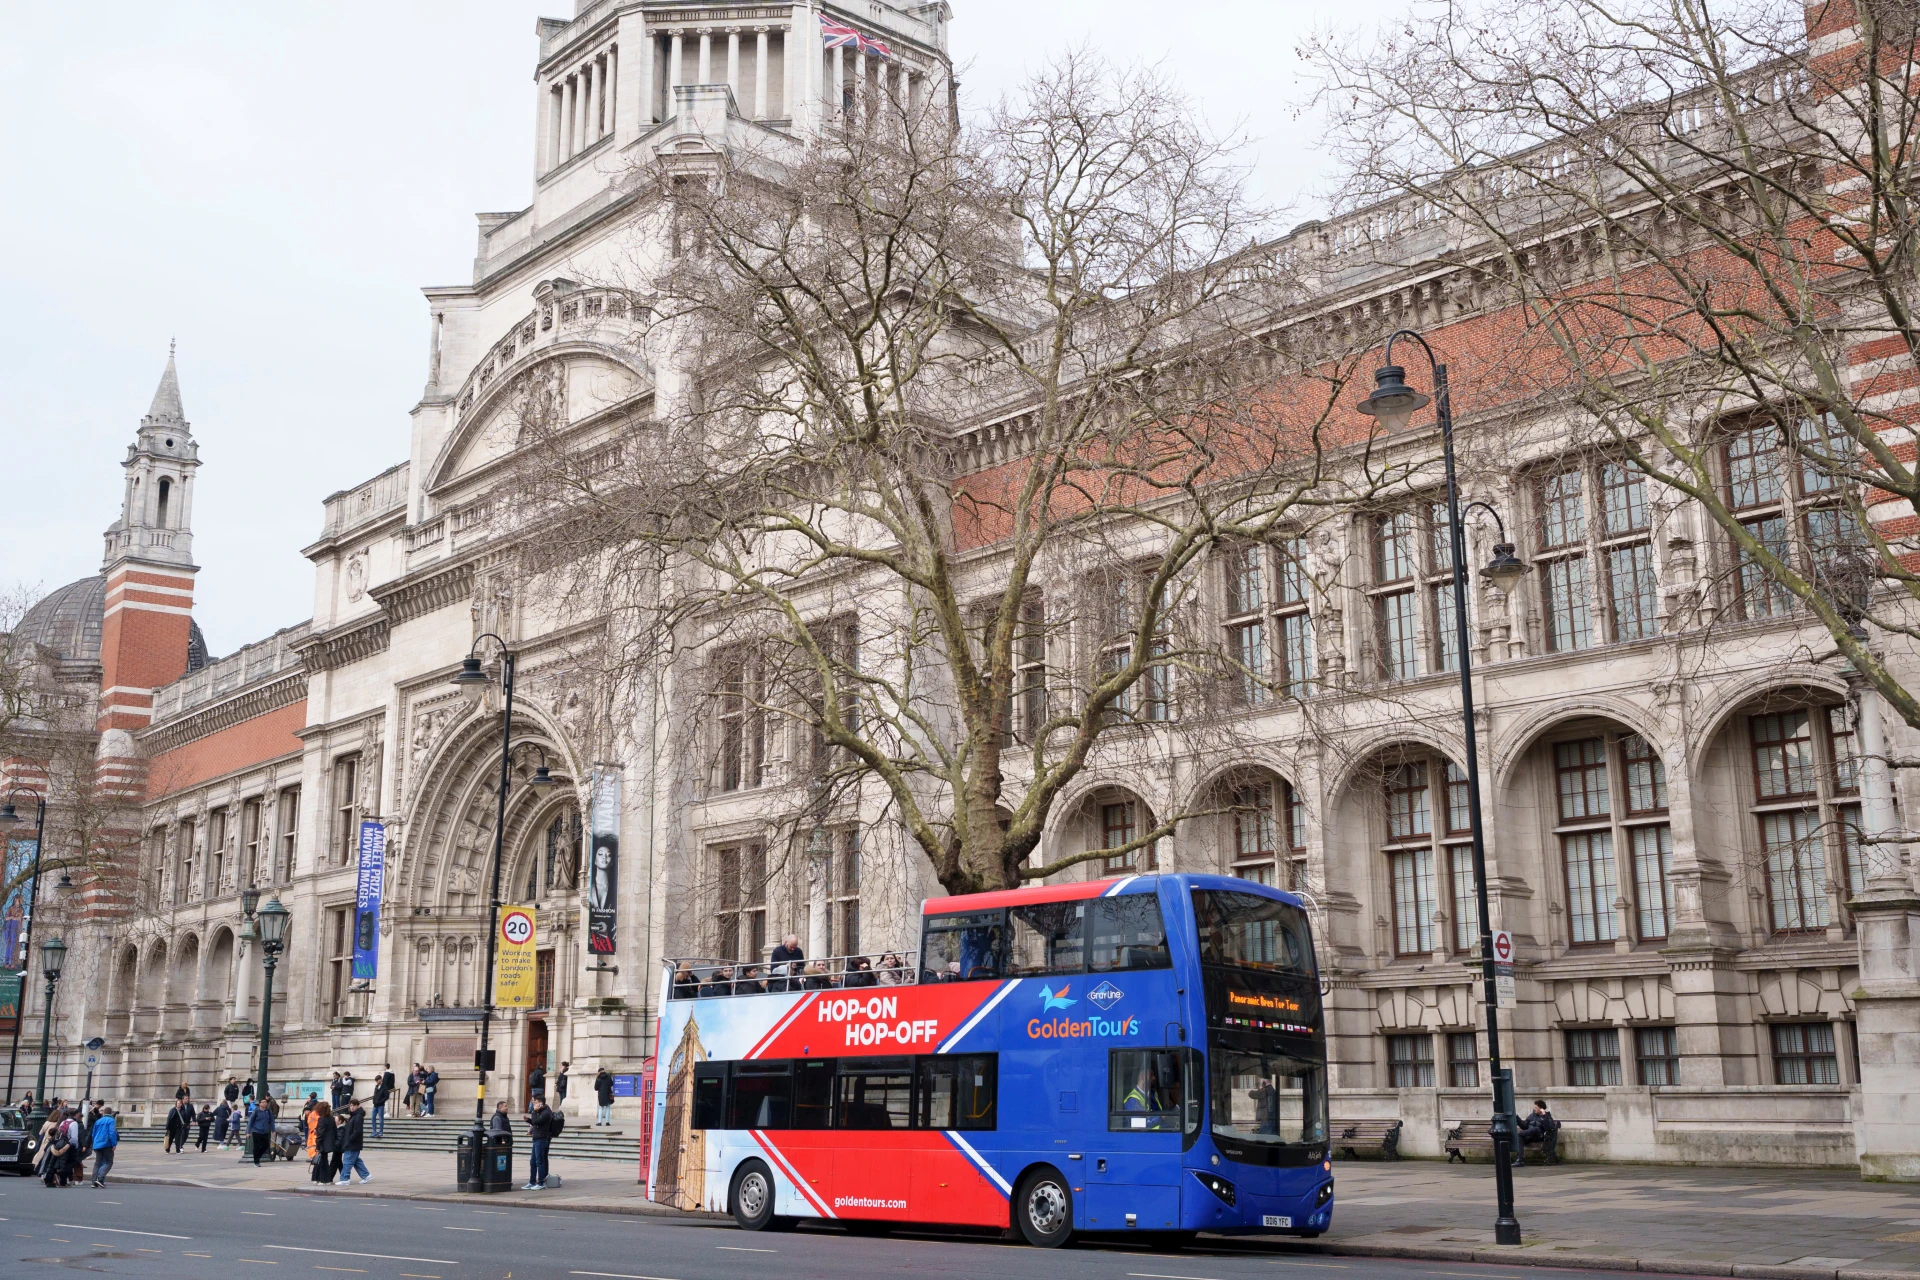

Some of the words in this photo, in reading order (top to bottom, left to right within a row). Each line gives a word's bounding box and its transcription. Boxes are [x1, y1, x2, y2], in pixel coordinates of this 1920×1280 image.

[361, 827, 373, 868] MOVING
[371, 828, 383, 867] JAMEEL
[358, 869, 370, 908] IMAGES
[369, 869, 380, 899] PRIZE
[507, 921, 528, 935] 20
[502, 949, 531, 957] Working
[1107, 990, 1121, 999] Line
[1229, 991, 1260, 1006] Panoramic
[1286, 999, 1299, 1011] Tour
[818, 996, 897, 1023] HOP-ON
[845, 1019, 938, 1046] HOP-OFF
[834, 1195, 907, 1209] goldentours.com
[1278, 1217, 1289, 1226] YFC
